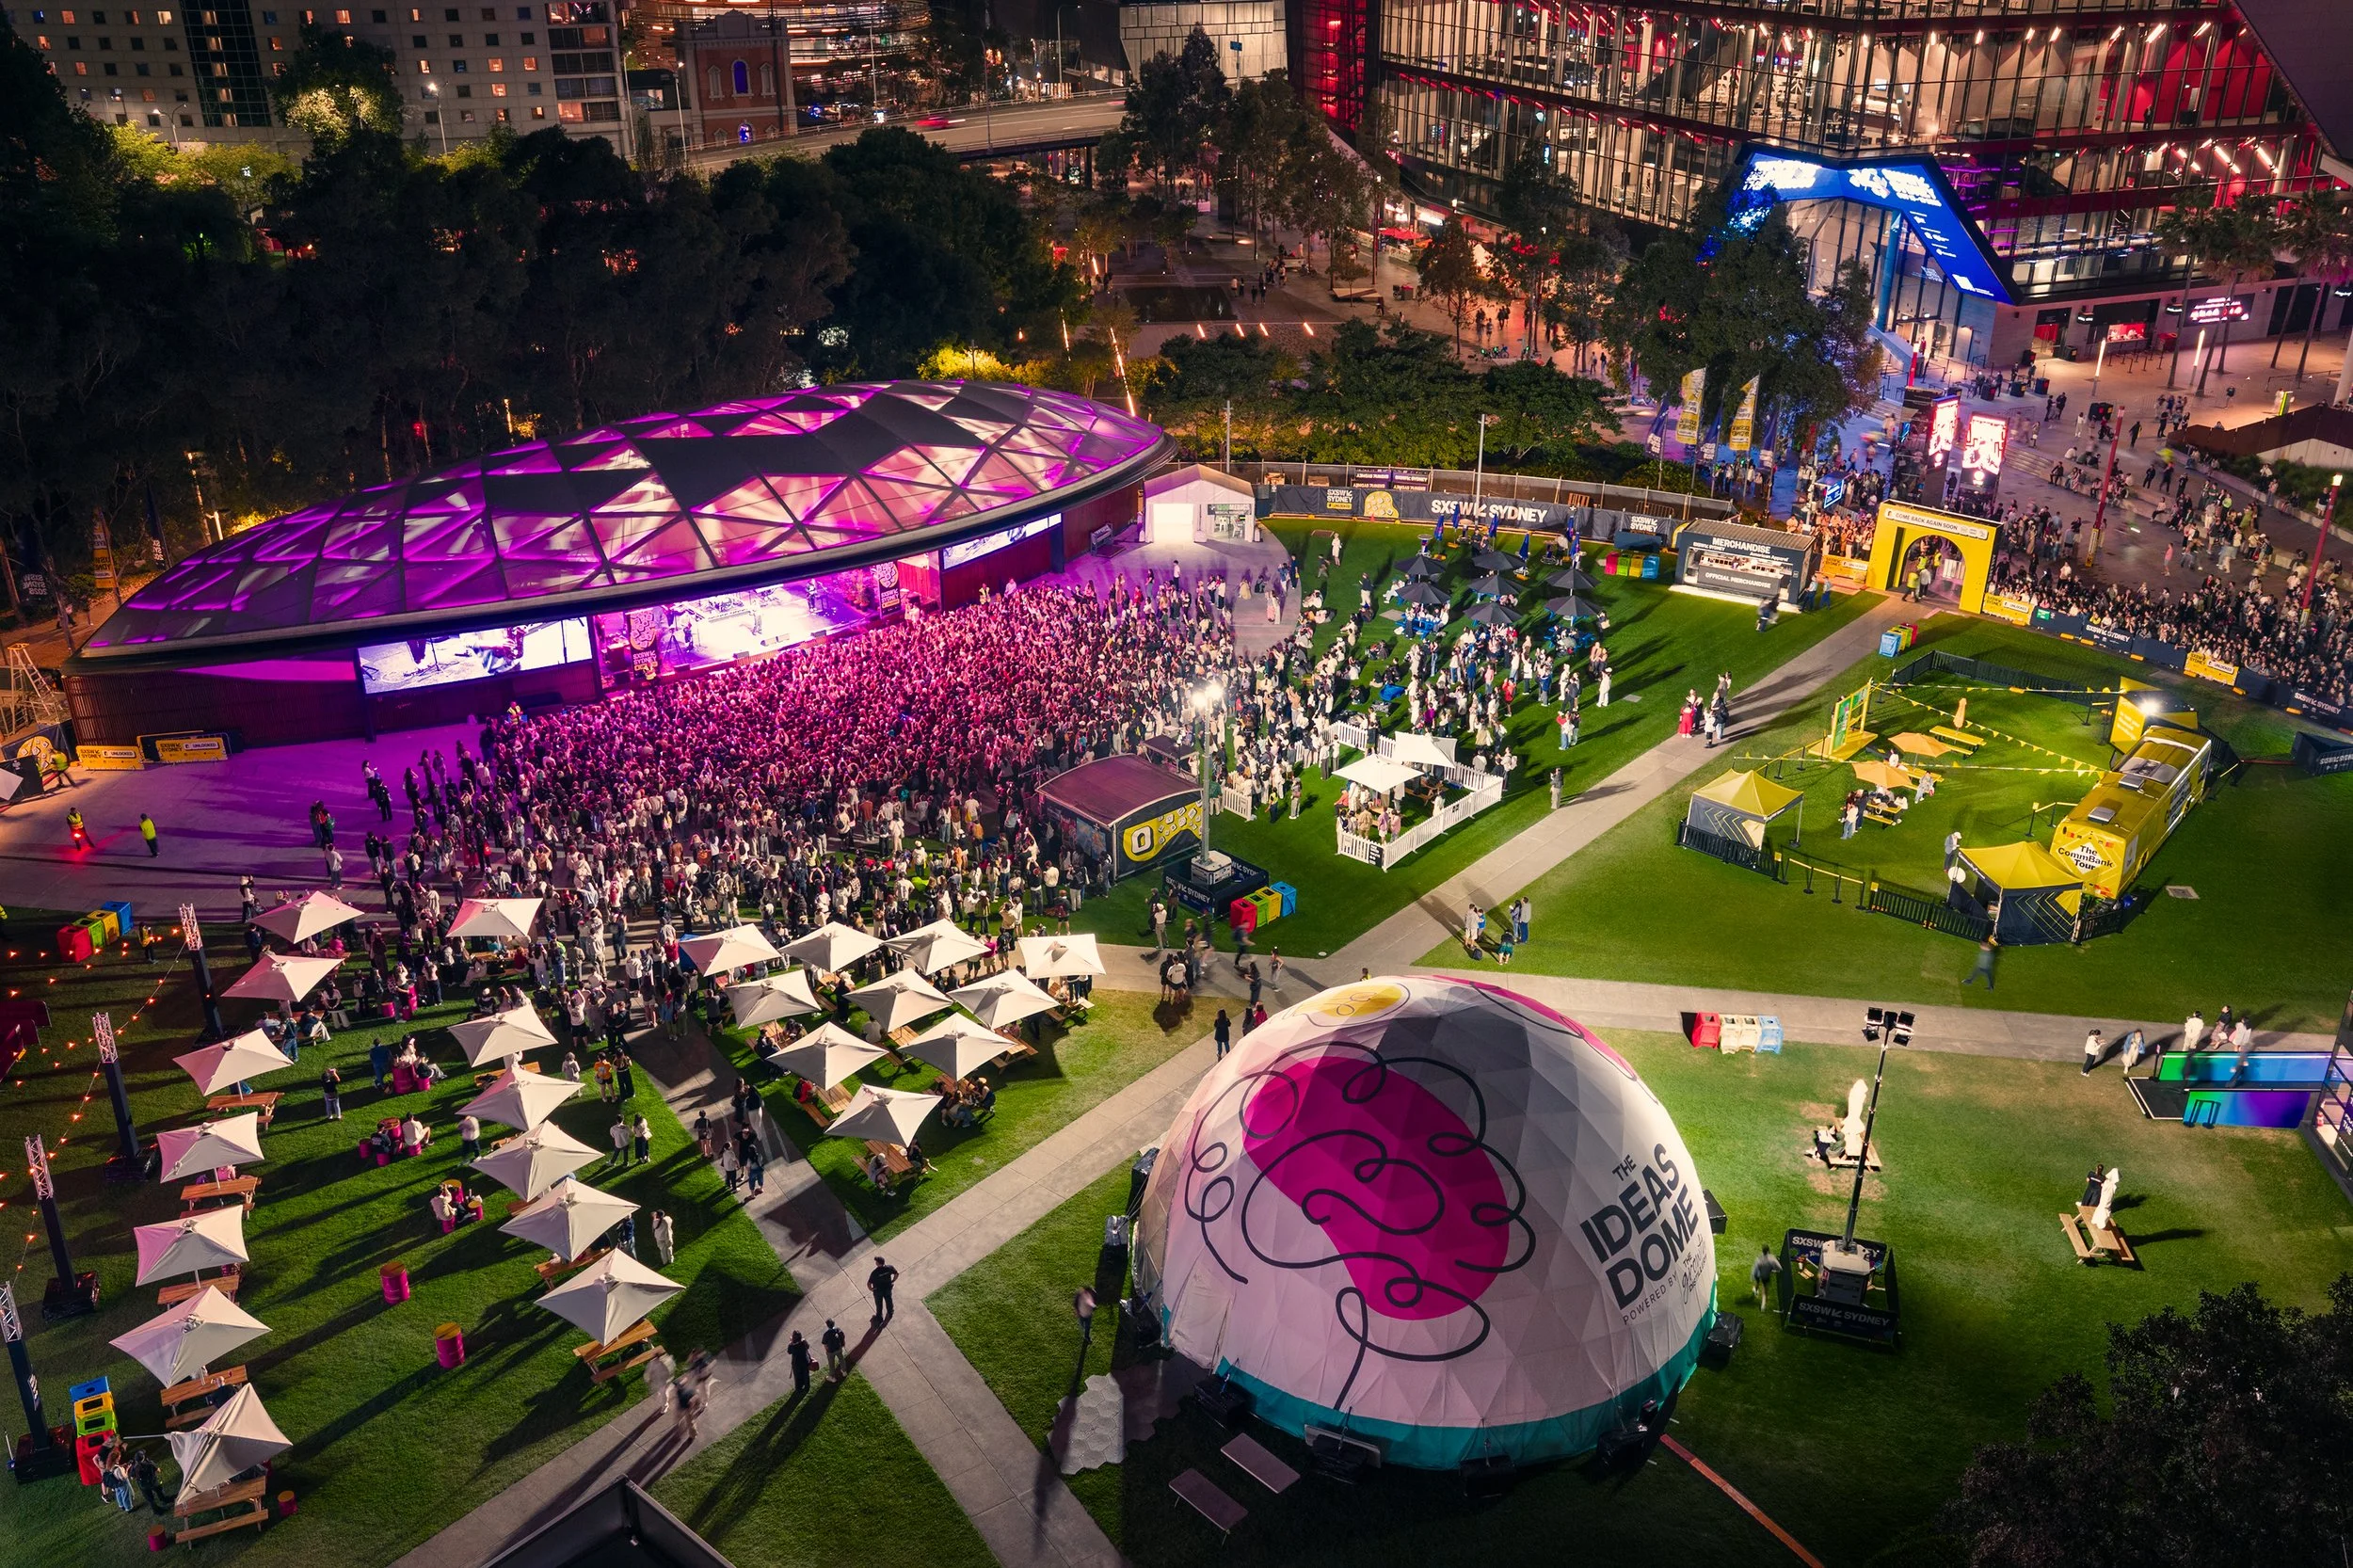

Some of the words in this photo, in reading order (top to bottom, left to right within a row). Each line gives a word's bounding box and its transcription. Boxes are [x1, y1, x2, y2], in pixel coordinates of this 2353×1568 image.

[1431, 499, 1473, 516] SXSW
[1489, 503, 1547, 523] SYDNEY
[1630, 522, 1657, 533] SYDNEY
[1631, 516, 1652, 524] SXSW
[1896, 512, 1910, 520] COME
[1944, 522, 1958, 531] SOON
[1712, 537, 1771, 554] MERCHANDISE
[1705, 571, 1730, 582] OFFICIAL
[1731, 576, 1771, 588] MERCHANDISE
[2107, 632, 2130, 643] SYDNEY
[2317, 701, 2341, 714] SYDNEY
[2058, 847, 2114, 868] CommBank
[2080, 845, 2098, 856] The
[2073, 858, 2096, 871] Tour
[1187, 888, 1210, 904] SYDNEY
[1612, 1154, 1637, 1181] THE
[1579, 1143, 1680, 1264] IDEAS
[1605, 1184, 1699, 1311] DOME
[1683, 1252, 1693, 1268] THE
[1623, 1283, 1667, 1325] POWERED
[1668, 1272, 1678, 1288] BY
[1799, 1302, 1833, 1315] SXSW
[1845, 1311, 1890, 1326] SYDNEY
